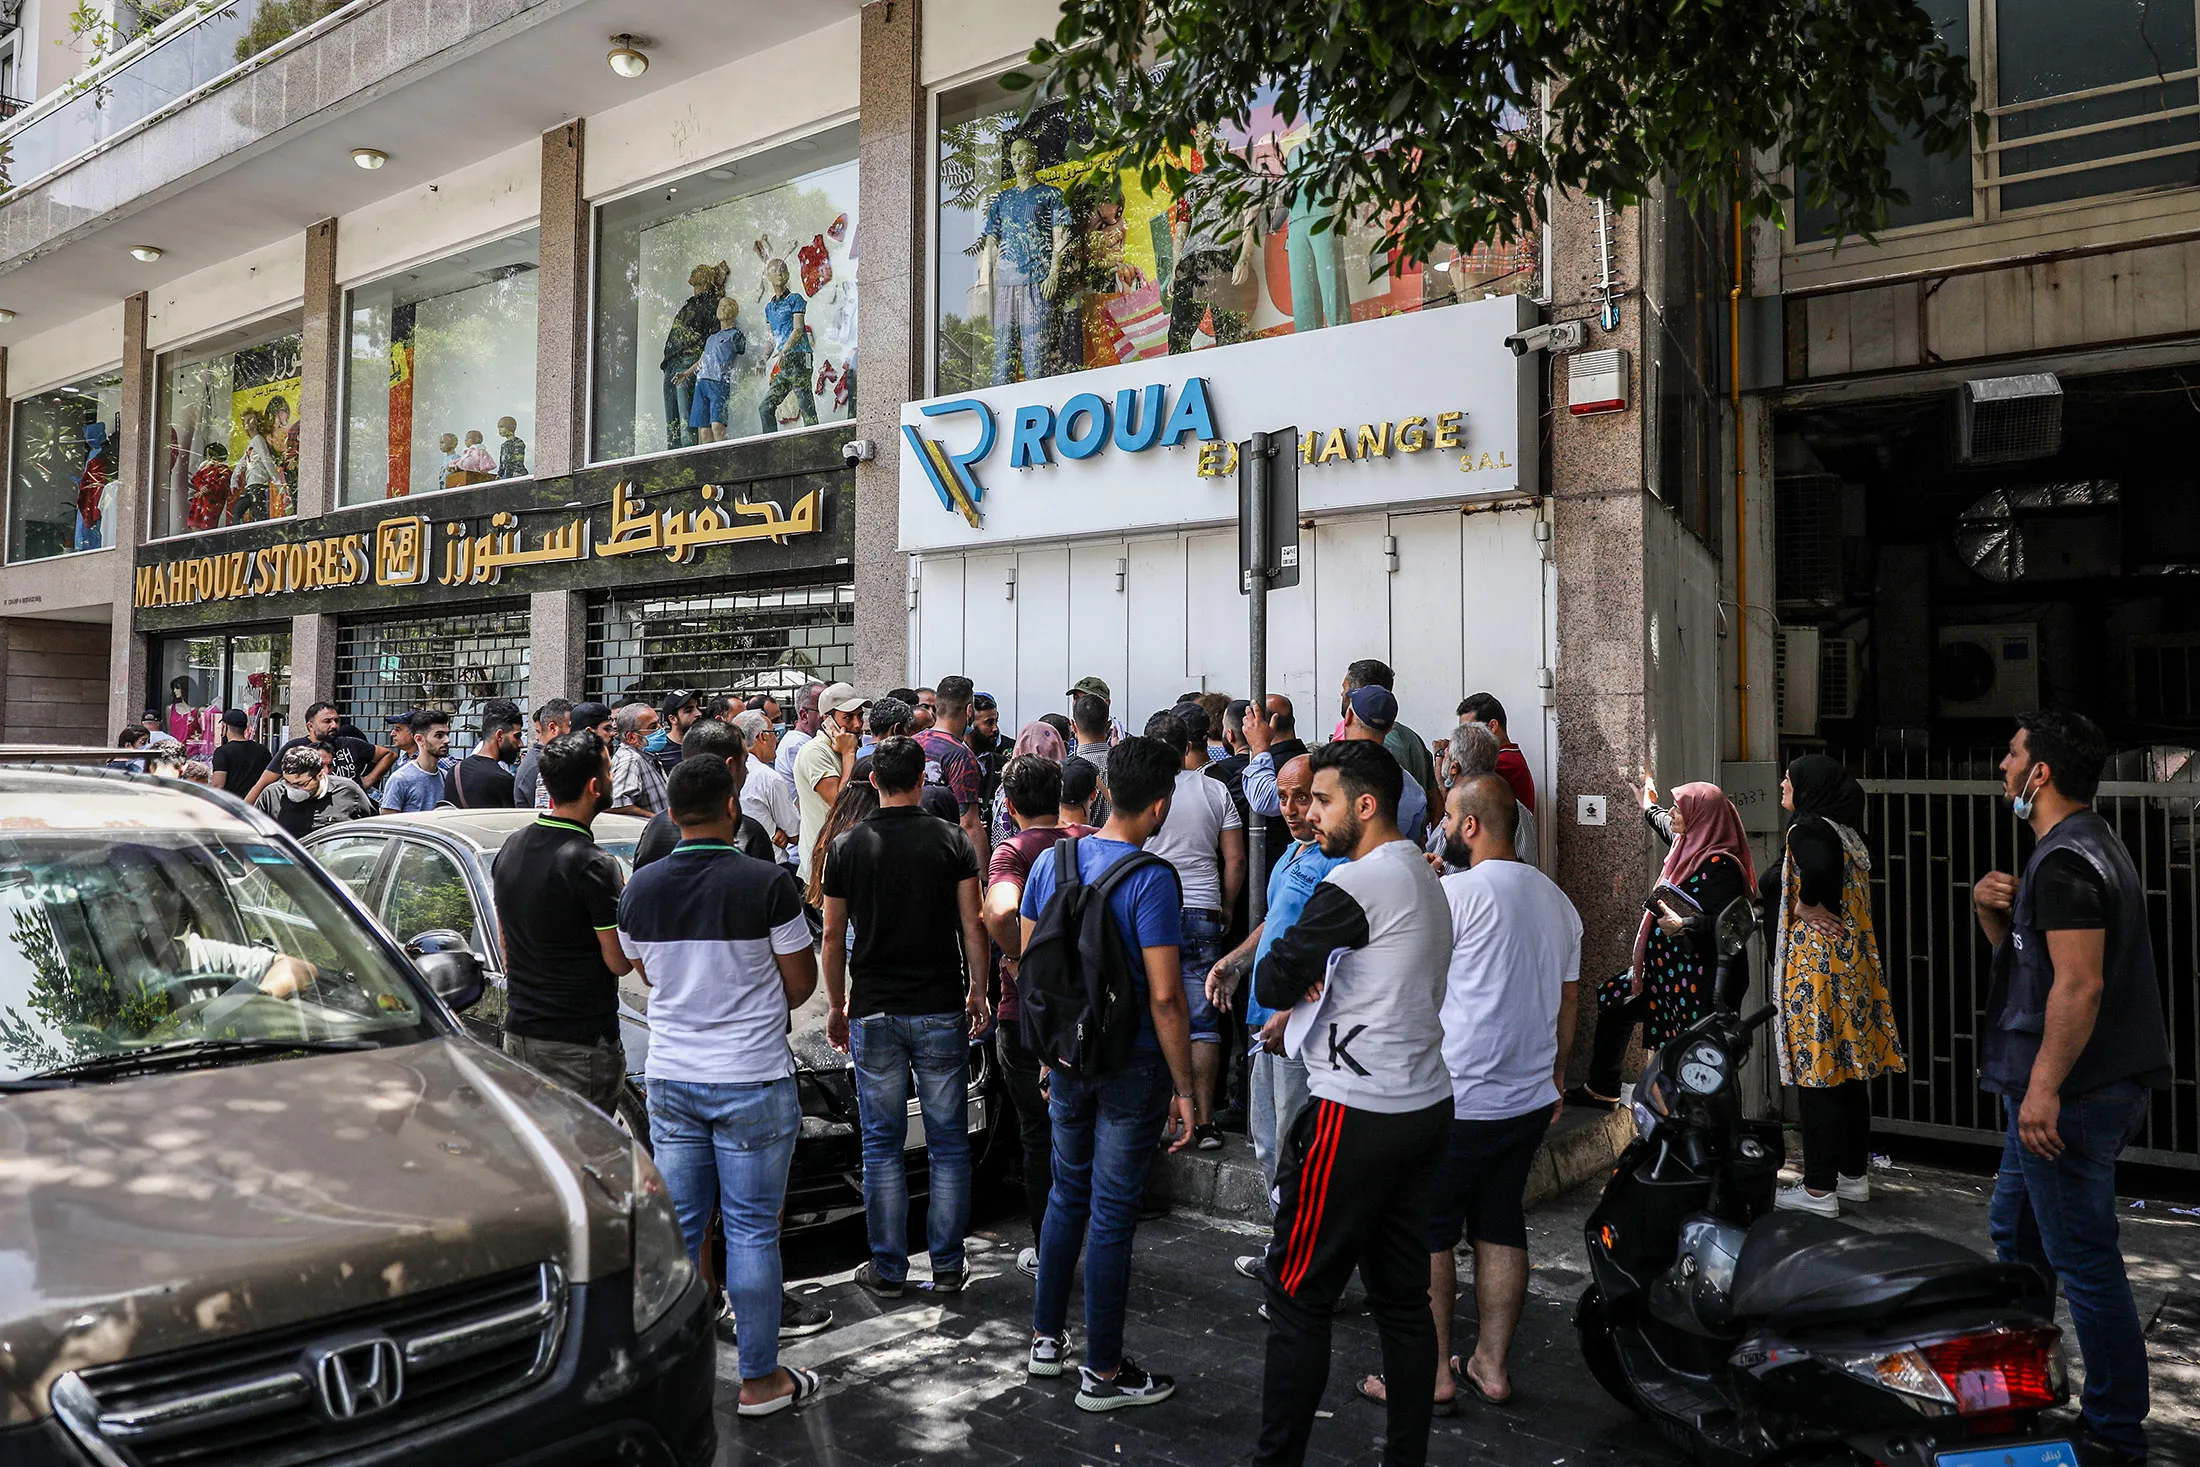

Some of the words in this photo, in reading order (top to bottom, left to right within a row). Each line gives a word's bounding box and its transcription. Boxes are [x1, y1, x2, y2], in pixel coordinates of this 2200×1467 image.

[1010, 377, 1217, 468] ROUA
[1197, 410, 1465, 478] EXHANGE
[438, 511, 587, 585] ستورز
[595, 481, 823, 563] محفوظ
[135, 550, 250, 608] MAHFOUZ
[254, 534, 364, 596] STORES
[1327, 1022, 1373, 1077] K
